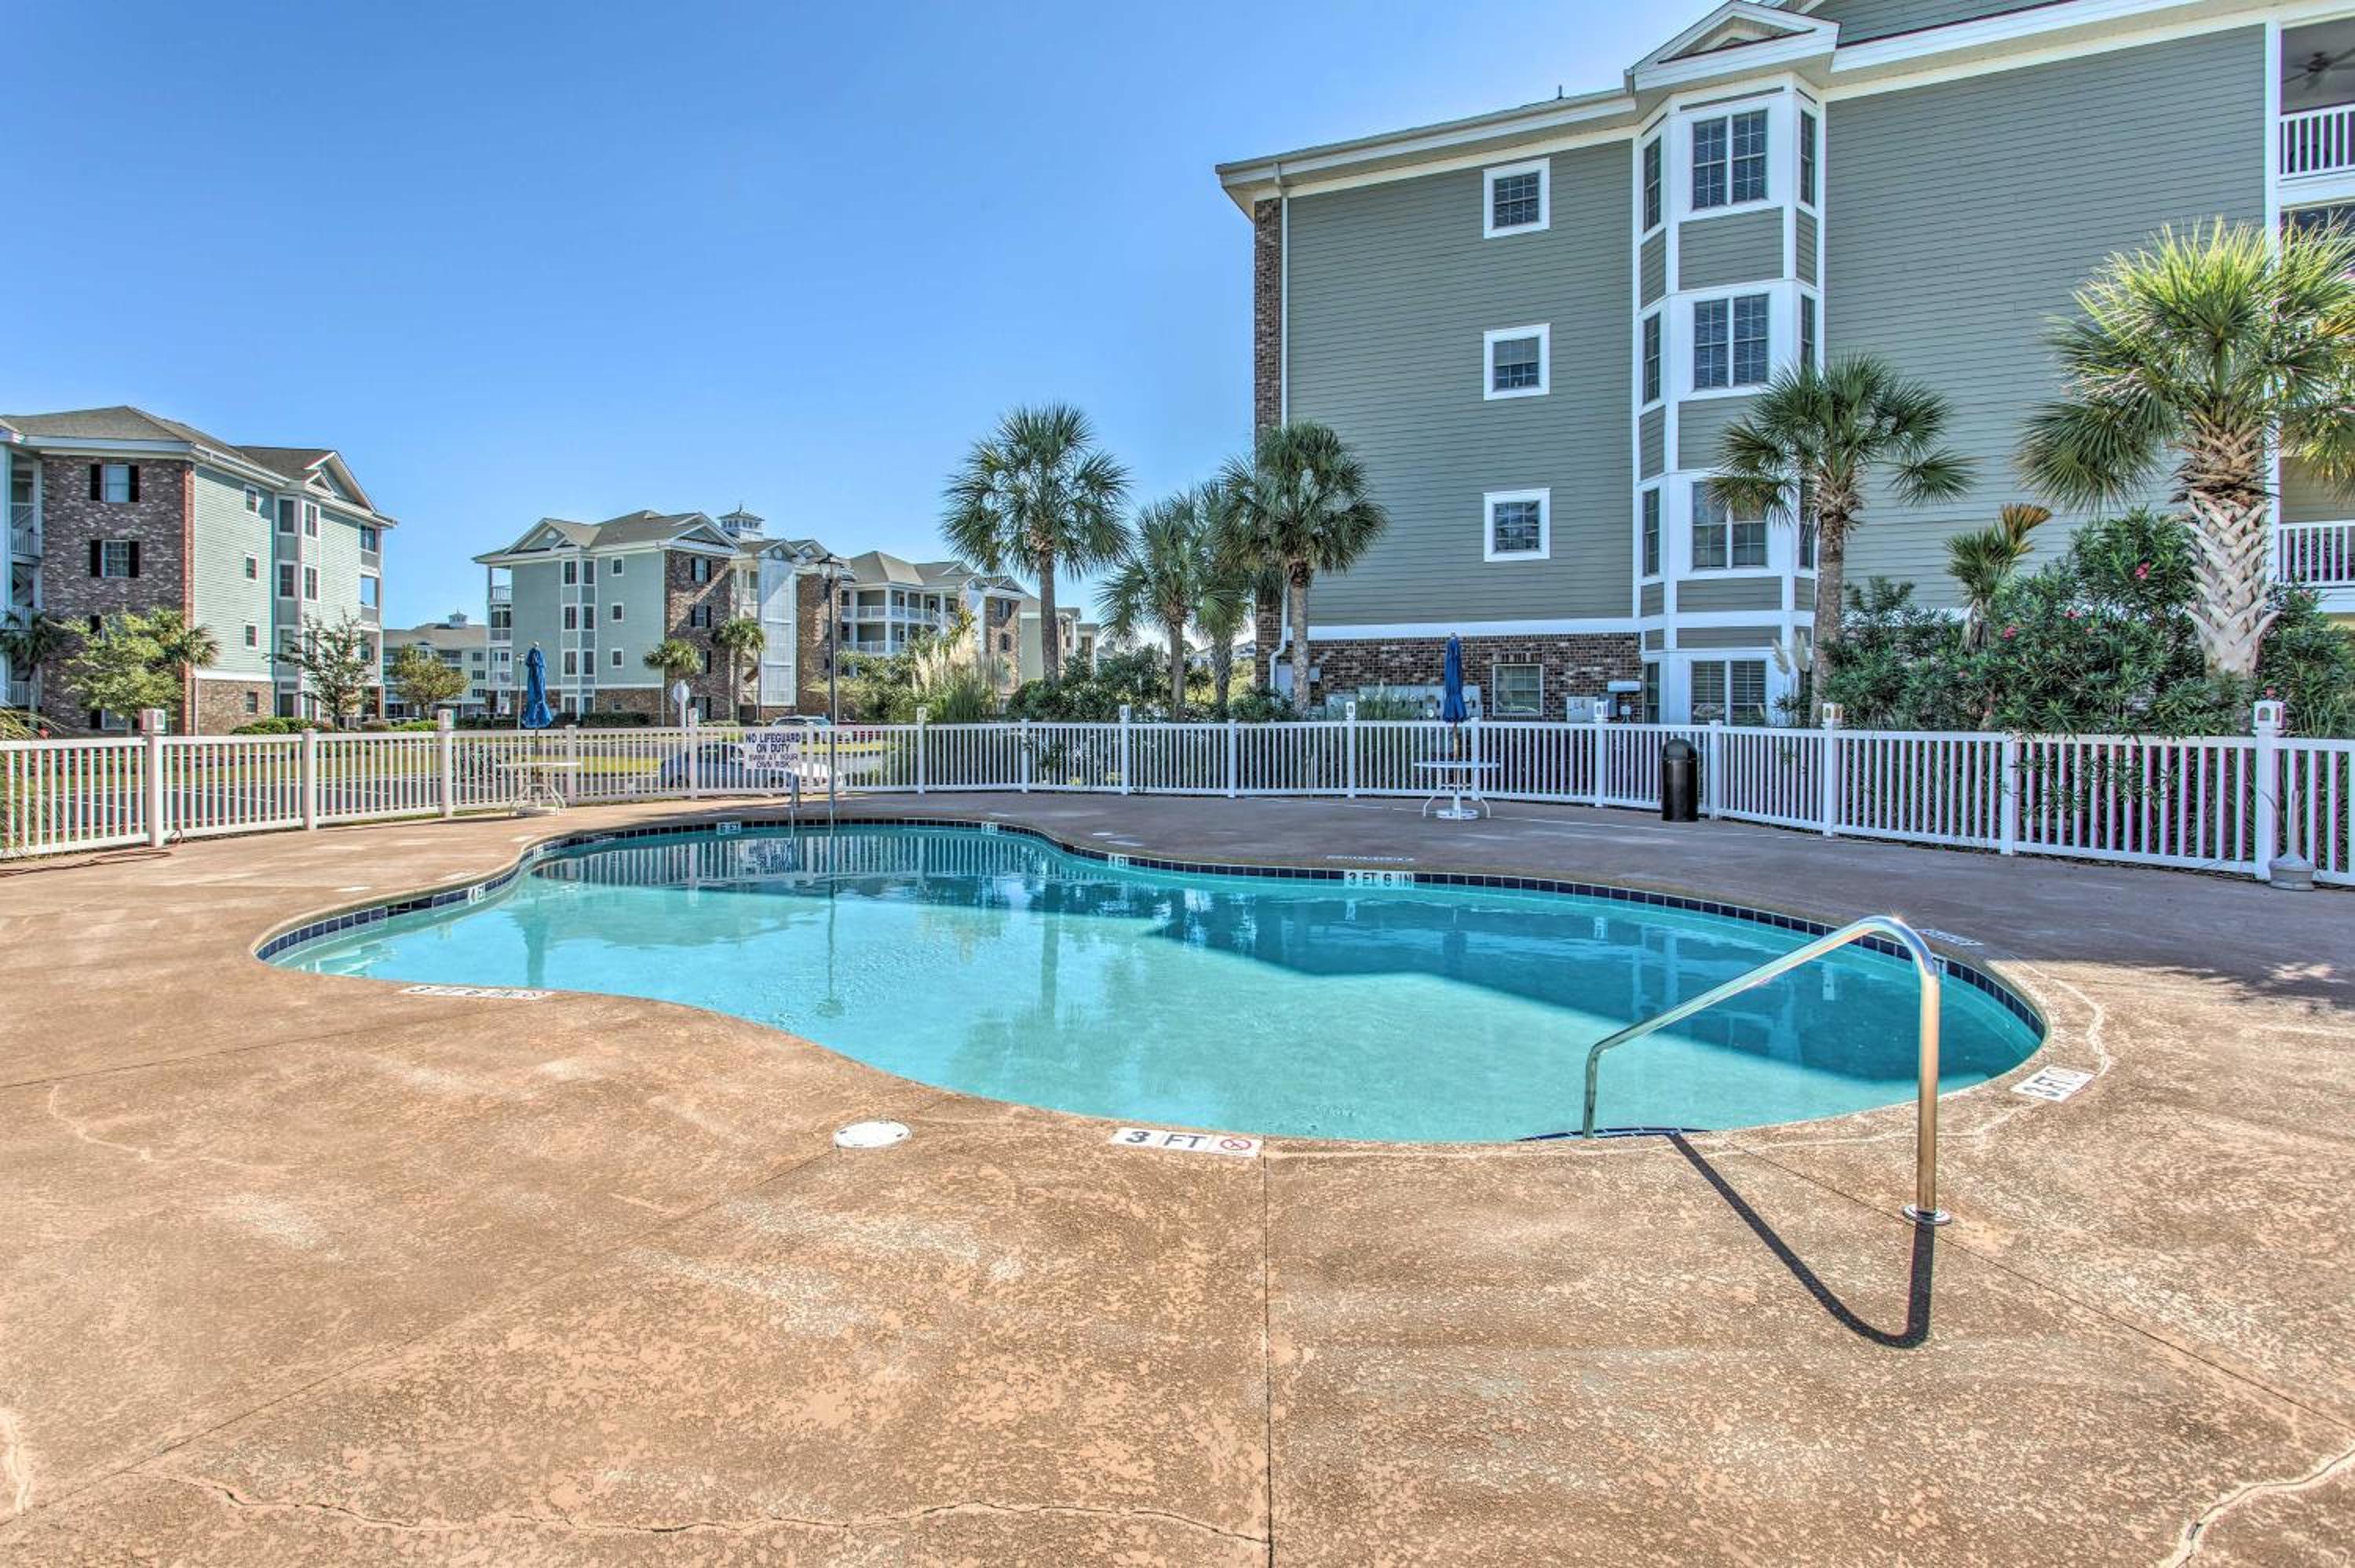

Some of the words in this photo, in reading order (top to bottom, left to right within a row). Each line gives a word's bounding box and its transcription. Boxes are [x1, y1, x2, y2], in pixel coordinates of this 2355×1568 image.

[745, 732, 757, 743] NO
[759, 732, 801, 743] LIFEGUARD
[756, 743, 767, 753] ON
[770, 743, 790, 753] DUTY
[1348, 872, 1357, 886] 3
[1362, 872, 1378, 886] FT
[1398, 873, 1412, 887] IN
[1124, 1130, 1152, 1144] 3
[1163, 1133, 1208, 1149] FT
